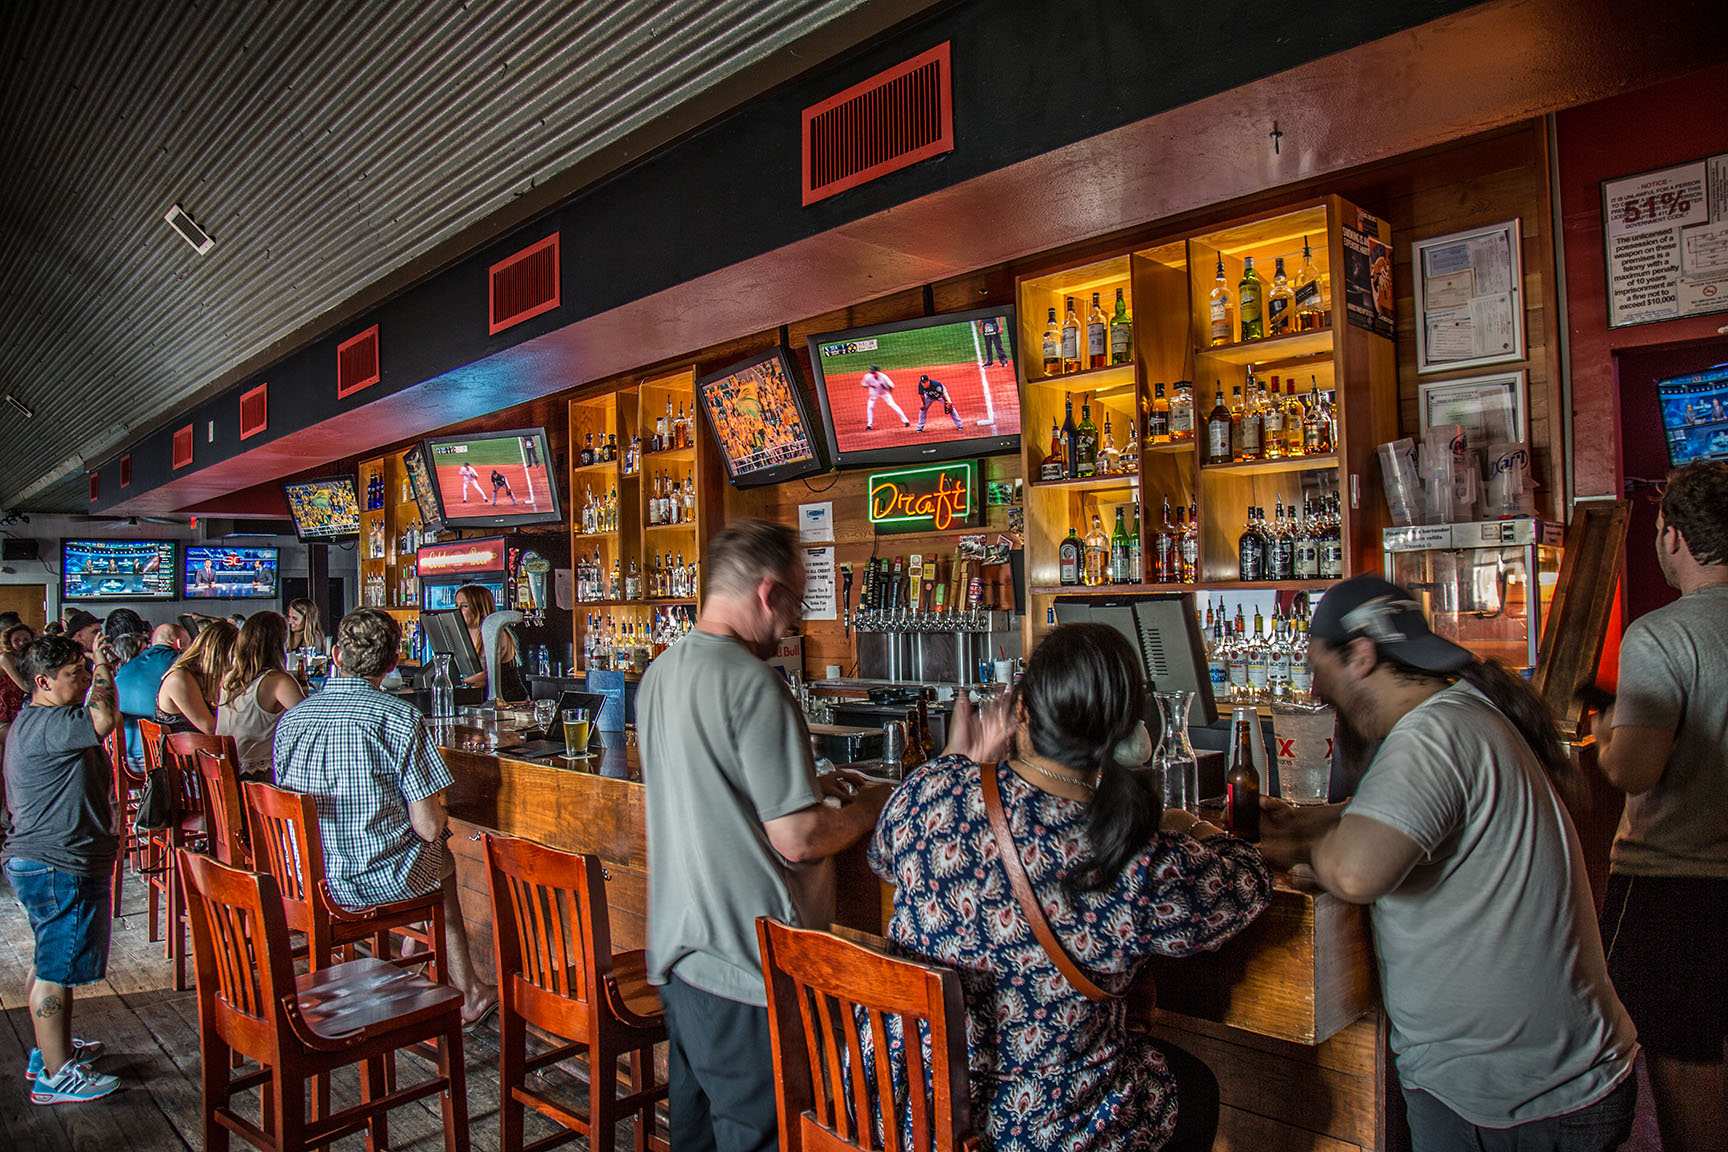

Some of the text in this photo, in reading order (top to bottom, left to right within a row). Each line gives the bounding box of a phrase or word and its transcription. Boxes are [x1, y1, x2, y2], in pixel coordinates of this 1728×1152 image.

[1624, 190, 1655, 200] UNLAWFUL
[1675, 180, 1701, 189] PERSON
[1641, 180, 1668, 189] NOTICE
[1624, 190, 1690, 223] 51%
[1625, 216, 1666, 229] GOVERNMENT
[1632, 228, 1672, 241] unlicensed
[1614, 249, 1643, 259] weapon
[1656, 243, 1676, 251] these
[1616, 239, 1658, 253] possession
[1621, 255, 1655, 266] premises
[1614, 265, 1679, 281] maximum penalty
[1623, 264, 1645, 272] felony
[1646, 275, 1667, 284] years
[1615, 282, 1665, 296] imprisonment
[1619, 295, 1676, 310] exceed $10,000
[871, 472, 966, 530] Draft
[223, 556, 244, 566] SC
[784, 645, 800, 656] Bull
